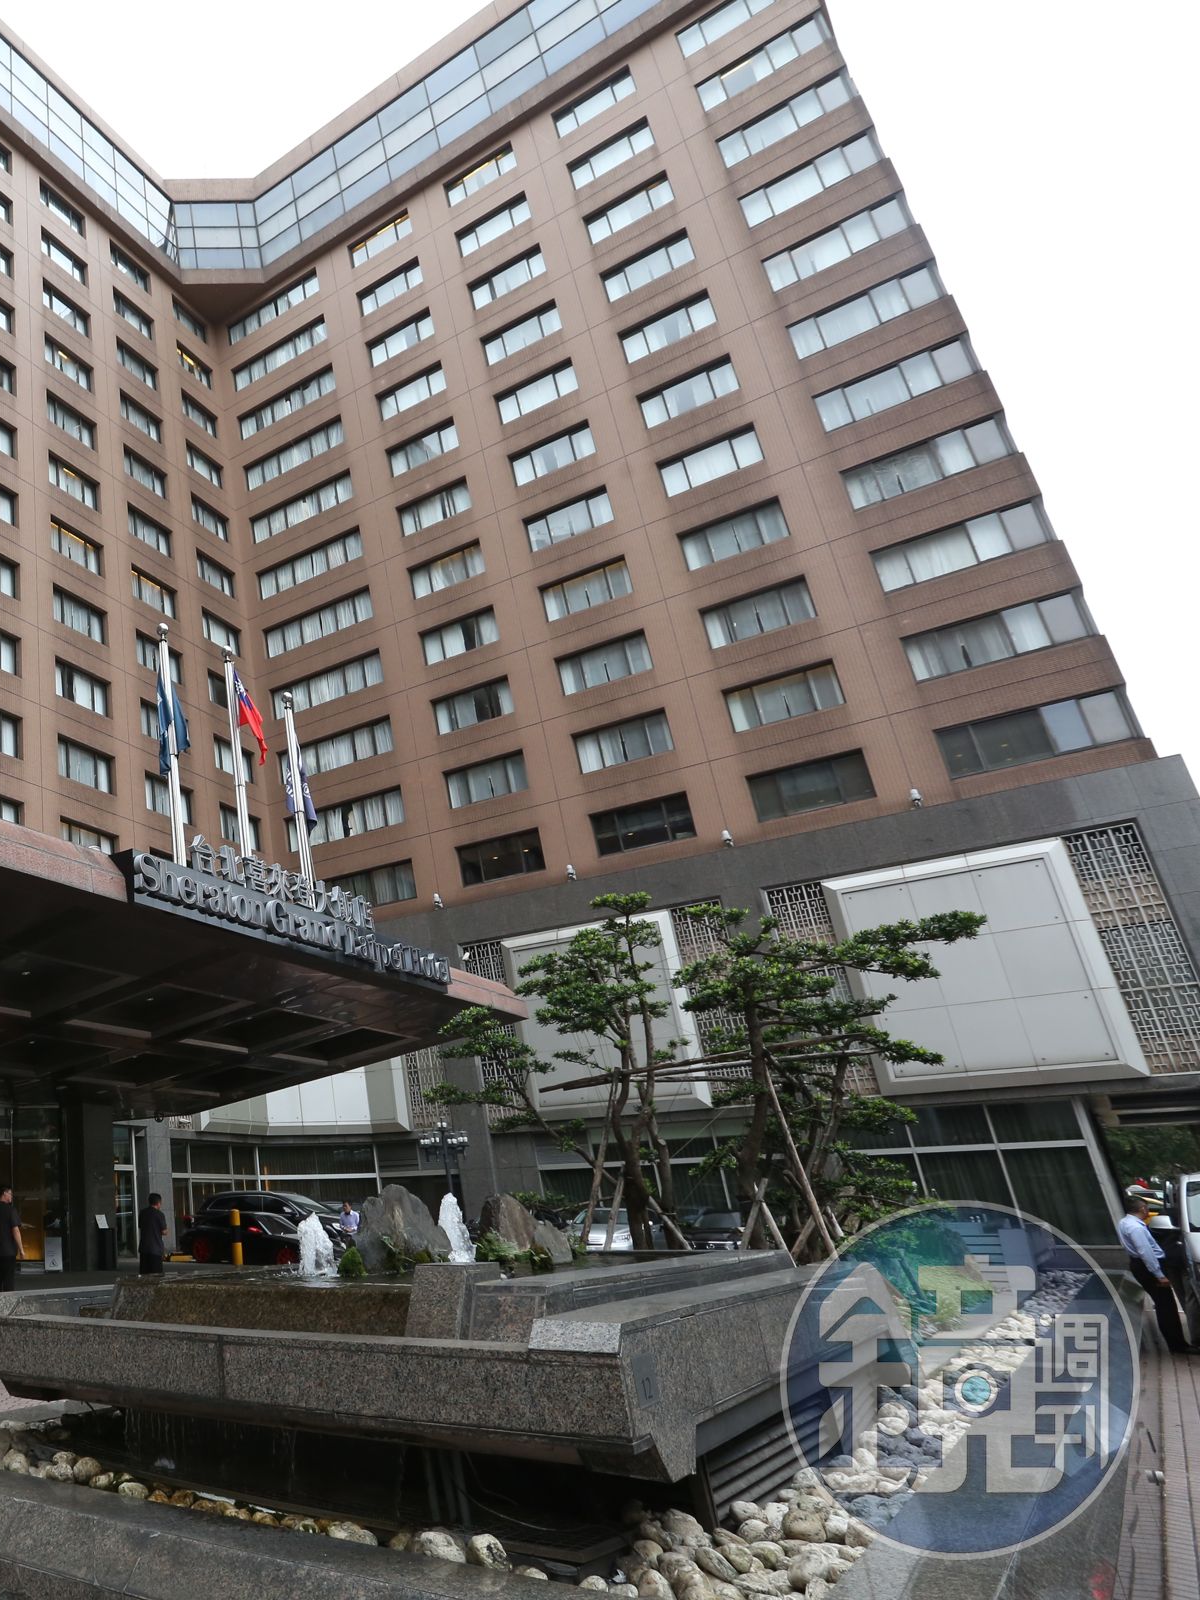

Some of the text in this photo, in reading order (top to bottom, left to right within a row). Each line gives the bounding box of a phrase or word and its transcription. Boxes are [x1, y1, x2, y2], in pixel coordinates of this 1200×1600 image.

[134, 853, 452, 984] Sheraton Grand Taipei Hotel
